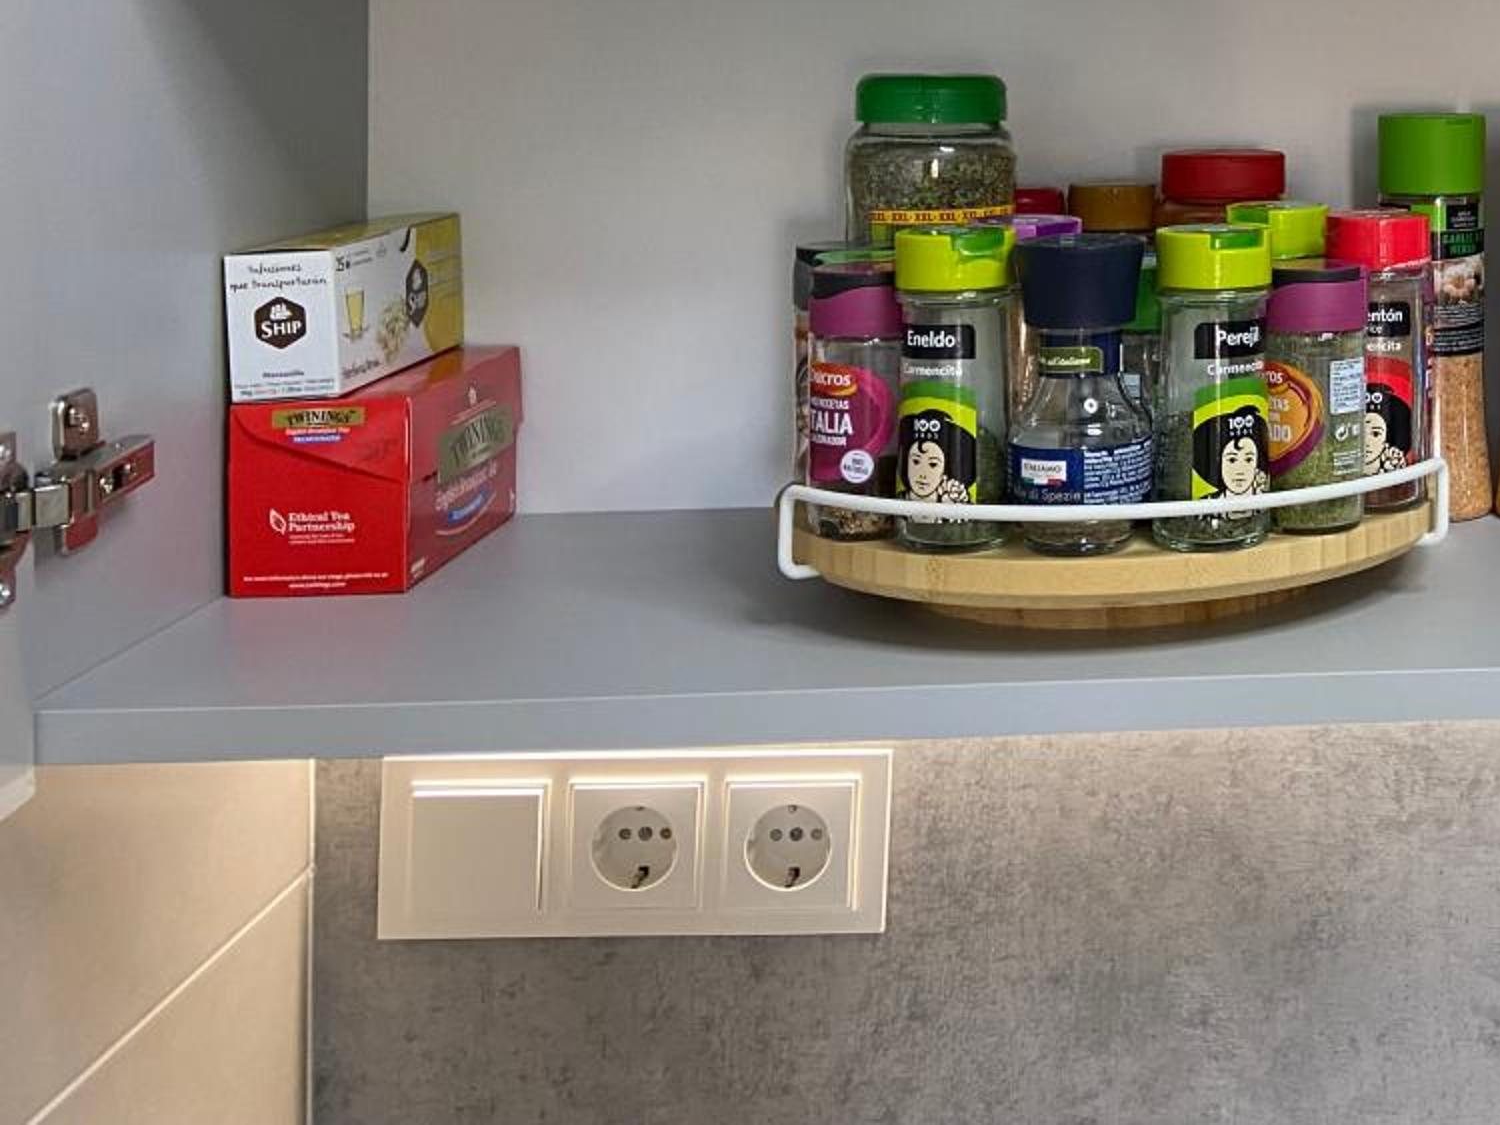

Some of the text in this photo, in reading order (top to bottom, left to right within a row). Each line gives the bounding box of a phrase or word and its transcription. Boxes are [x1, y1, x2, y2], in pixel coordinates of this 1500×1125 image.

[1367, 308, 1403, 322] entón
[261, 321, 302, 339] SHIP
[907, 330, 956, 348] Eneldo
[287, 409, 352, 426] TWININGS
[914, 419, 941, 432] 100
[288, 511, 350, 522] Ethical Tea
[288, 522, 355, 533] Partnership
